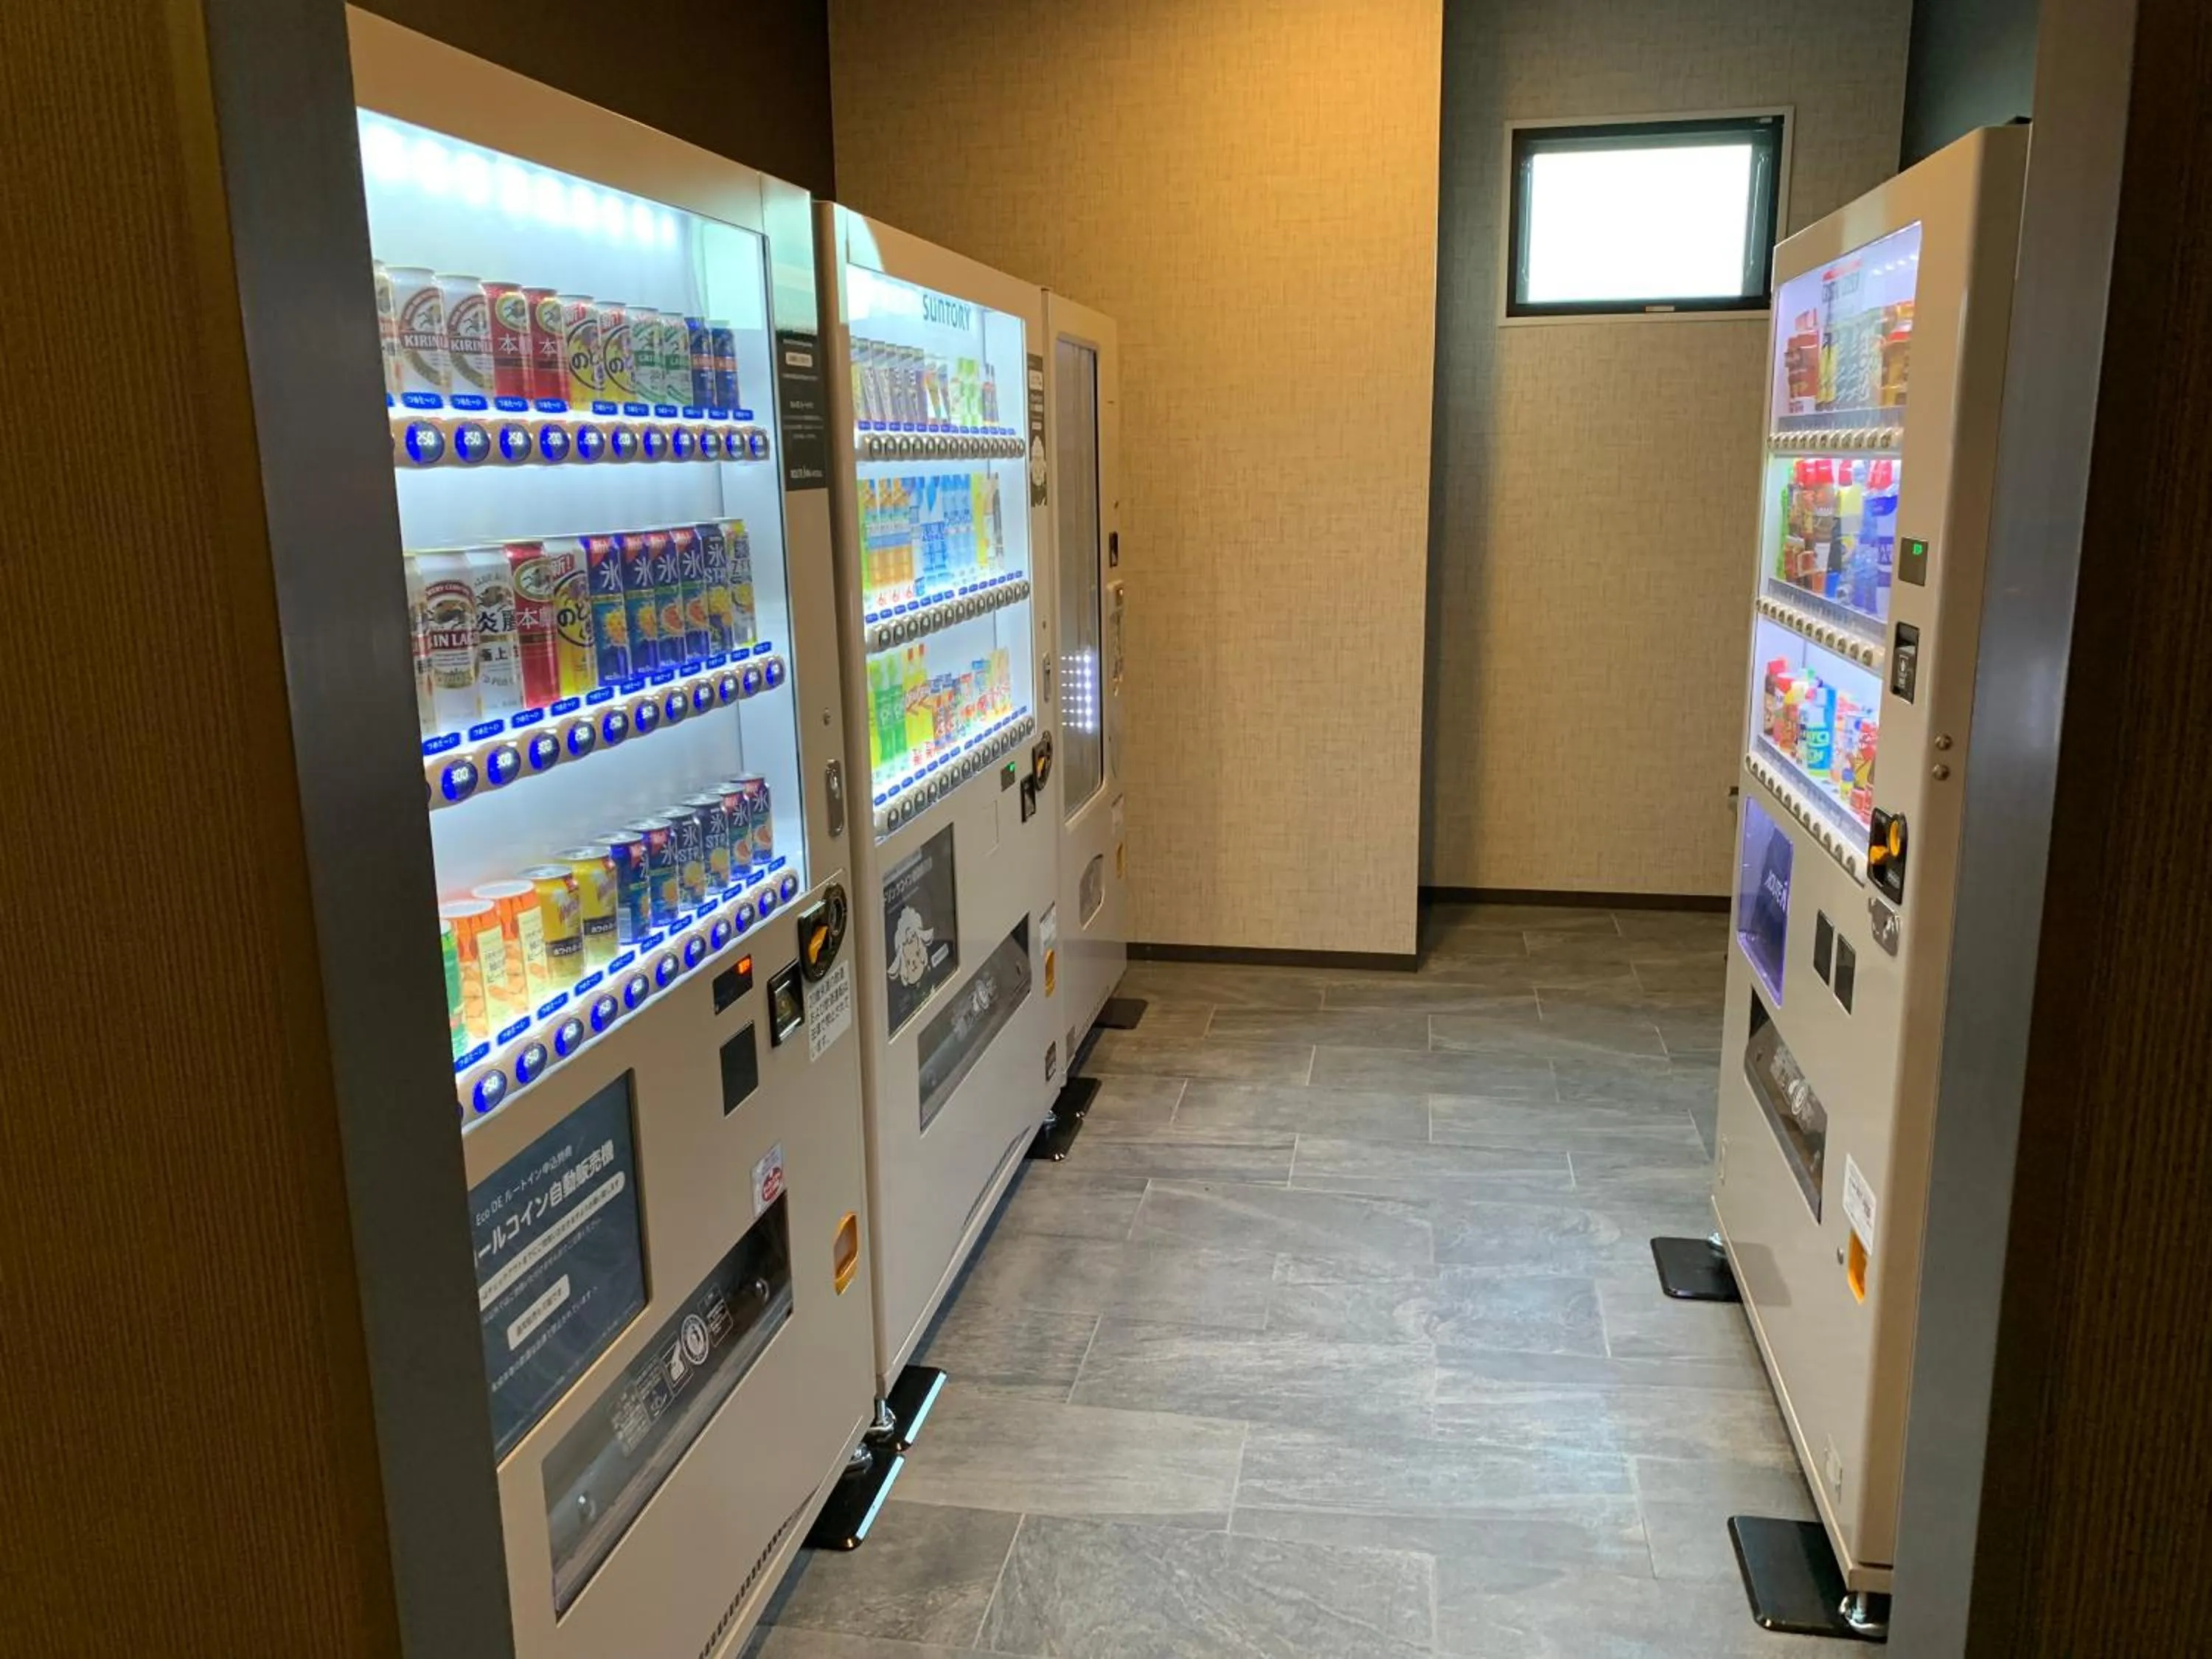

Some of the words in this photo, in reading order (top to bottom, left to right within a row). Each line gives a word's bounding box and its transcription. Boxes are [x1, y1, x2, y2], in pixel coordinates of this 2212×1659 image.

[922, 294, 971, 331] SUNTORY
[403, 334, 440, 349] KIRIN
[450, 340, 484, 353] KIRIN
[416, 431, 435, 446] 250
[464, 431, 481, 445] 250
[507, 431, 524, 445] 250
[451, 766, 469, 784] 300
[473, 1139, 614, 1268] ールコイン自動販売機
[476, 1207, 490, 1227] Eco
[490, 1194, 504, 1214] DE
